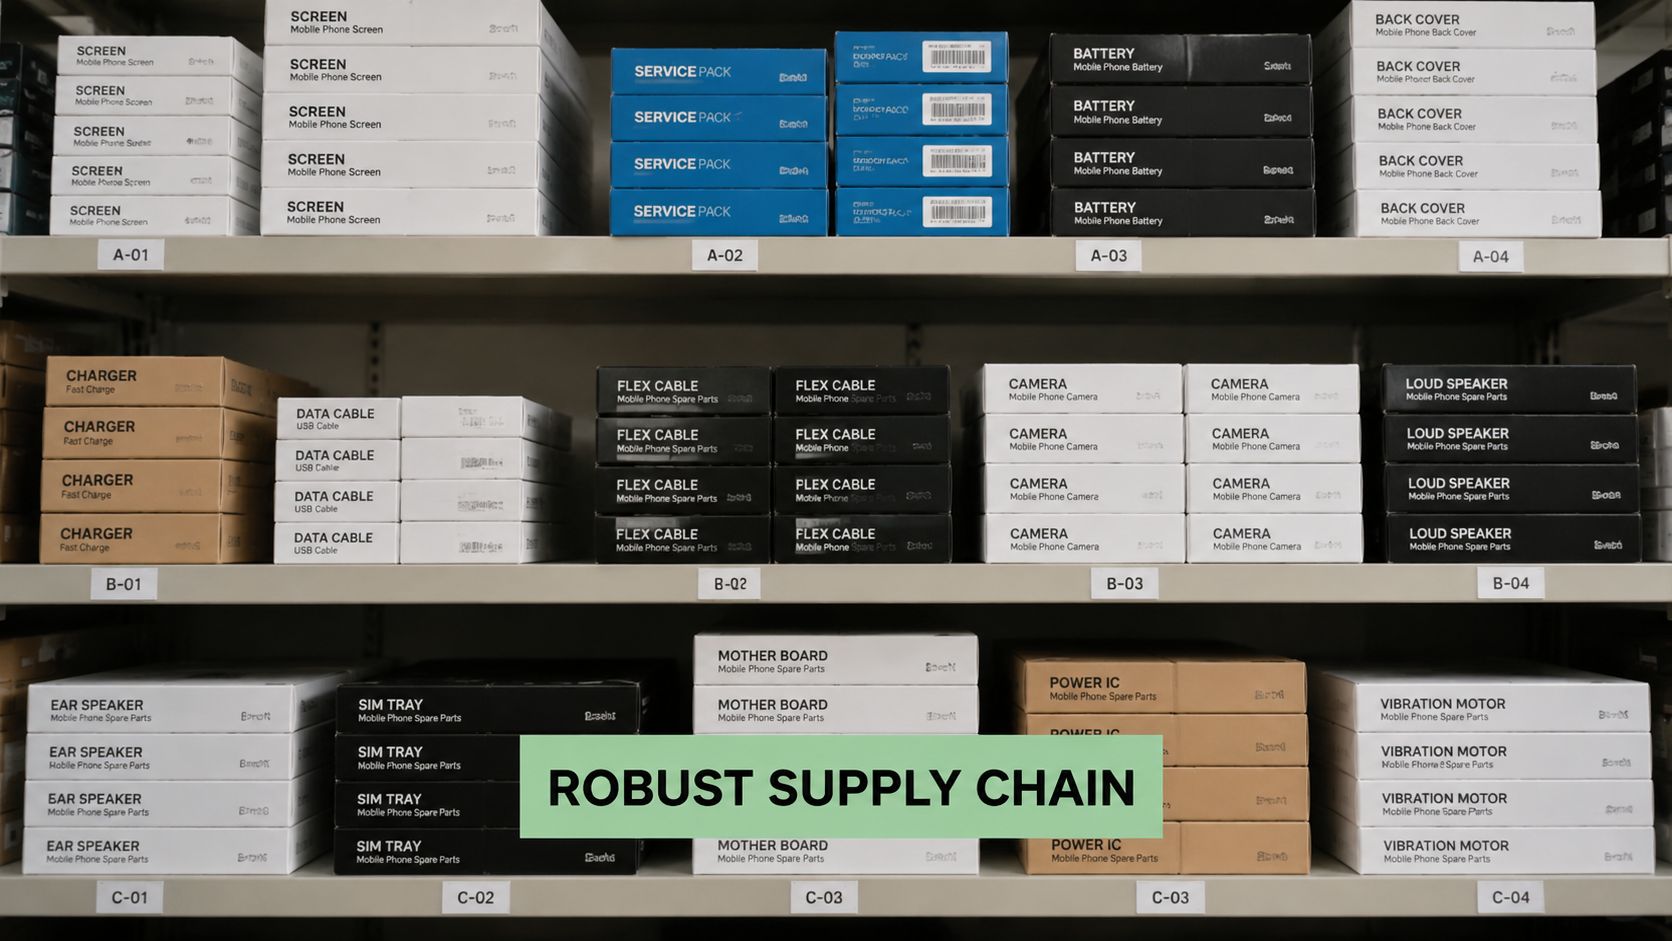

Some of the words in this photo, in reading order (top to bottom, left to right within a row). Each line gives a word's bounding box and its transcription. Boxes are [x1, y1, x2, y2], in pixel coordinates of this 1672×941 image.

[291, 11, 347, 22] SCREEN
[1376, 14, 1412, 25] BACK
[1415, 14, 1460, 25] COVER
[1405, 28, 1430, 36] Phone
[1432, 28, 1452, 36] Back
[1453, 28, 1477, 37] Cover
[77, 46, 126, 56] SCREEN
[1074, 48, 1135, 59] BATTERY
[290, 59, 346, 70] SCREEN
[1377, 61, 1413, 72] BACK
[1416, 61, 1460, 72] COVER
[635, 65, 697, 77] SERVICE
[699, 67, 731, 77] PACK
[76, 85, 125, 96] SCREEN
[289, 106, 345, 117] SCREEN
[1074, 100, 1135, 112] BATTERY
[634, 111, 697, 123] SERVICE
[699, 112, 730, 123] PACK
[1378, 108, 1414, 119] BACK
[1417, 108, 1462, 119] COVER
[320, 120, 347, 129] Phone
[349, 120, 381, 129] Screen
[74, 126, 124, 137] SCREEN
[288, 153, 345, 165] SCREEN
[1074, 152, 1135, 163] BATTERY
[1379, 155, 1415, 166] BACK
[1419, 155, 1463, 166] COVER
[634, 158, 696, 170] SERVICE
[699, 159, 730, 169] PACK
[1103, 166, 1130, 175] Phone
[1132, 166, 1163, 177] Battery
[70, 205, 121, 216] SCREEN
[287, 201, 344, 212] SCREEN
[634, 205, 696, 217] SERVICE
[699, 206, 730, 216] PACK
[1075, 202, 1136, 213] BATTERY
[1381, 203, 1417, 214] BACK
[1420, 203, 1465, 214] COVER
[113, 248, 147, 261] A-01
[707, 249, 743, 262] A-02
[1091, 249, 1127, 262] A-03
[1473, 250, 1509, 263] A-04
[66, 369, 137, 382] CHARGER
[618, 380, 650, 391] FLEX
[655, 380, 698, 392] CABLE
[796, 380, 828, 391] FLEX
[832, 379, 875, 391] CABLE
[1009, 378, 1067, 389] CAMERA
[1211, 378, 1269, 390] CAMERA
[1406, 378, 1443, 389] LOUD
[1447, 378, 1508, 389] SPEAKER
[1434, 393, 1460, 401] Phone
[1462, 392, 1485, 402] Spare
[1486, 392, 1507, 401] Parts
[297, 408, 330, 419] DATA
[333, 408, 374, 419] CABLE
[64, 420, 135, 433] CHARGER
[617, 429, 651, 441] FLEX
[655, 429, 698, 441] CABLE
[796, 428, 828, 440] FLEX
[832, 428, 876, 440] CABLE
[1009, 428, 1067, 439] CAMERA
[1212, 428, 1269, 439] CAMERA
[1407, 428, 1444, 439] LOUD
[1448, 427, 1509, 439] SPEAKER
[296, 450, 330, 461] DATA
[333, 449, 374, 461] CABLE
[62, 474, 133, 487] CHARGER
[617, 479, 650, 491] FLEX
[654, 479, 698, 491] CABLE
[1010, 478, 1068, 489] CAMERA
[1213, 478, 1270, 489] CAMERA
[1409, 477, 1446, 489] LOUD
[1449, 477, 1510, 489] SPEAKER
[81, 490, 112, 501] Charge
[295, 491, 329, 502] DATA
[332, 491, 373, 502] CABLE
[1241, 492, 1267, 500] Phone
[1269, 492, 1301, 501] Camera
[60, 527, 133, 540] CHARGER
[294, 532, 328, 543] DATA
[331, 532, 373, 543] CABLE
[617, 528, 650, 540] FLEX
[654, 528, 698, 540] CABLE
[796, 528, 829, 540] FLEX
[832, 528, 875, 540] CABLE
[1010, 528, 1068, 539] CAMERA
[1213, 528, 1271, 539] CAMERA
[1410, 528, 1447, 539] LOUD
[1450, 528, 1511, 539] SPEAKER
[106, 578, 140, 591] B-01
[1107, 577, 1143, 590] B-03
[1493, 577, 1529, 590] B-04
[718, 650, 776, 661] MOTHER
[780, 650, 828, 661] BOARD
[748, 664, 775, 673] Phone
[777, 664, 801, 675] Spare
[803, 664, 825, 673] Parts
[1050, 677, 1102, 689] POWER
[1106, 677, 1120, 688] IC
[51, 699, 78, 711] EAR
[81, 699, 143, 711] SPEAKER
[359, 699, 383, 711] SIM
[387, 699, 423, 710] TRAY
[718, 699, 776, 710] MOTHER
[780, 699, 828, 710] BOARD
[1380, 698, 1452, 709] VIBRATION
[1456, 698, 1506, 709] MOTOR
[1411, 712, 1438, 721] Phone
[1440, 712, 1465, 722] Spare
[1466, 712, 1489, 721] Parts
[49, 746, 76, 758] EAR
[80, 746, 142, 758] SPEAKER
[358, 746, 383, 758] SIM
[386, 746, 423, 758] TRAY
[1381, 746, 1453, 757] VIBRATION
[1457, 746, 1507, 757] MOTOR
[357, 793, 382, 805] SIM
[386, 793, 422, 805] TRAY
[1382, 793, 1453, 804] VIBRATION
[1458, 793, 1507, 804] MOTOR
[47, 840, 73, 852] EAR
[77, 840, 140, 852] SPEAKER
[357, 840, 381, 852] SIM
[385, 840, 422, 852] TRAY
[718, 840, 776, 851] MOTHER
[780, 839, 828, 851] BOARD
[1052, 839, 1103, 851] POWER
[1108, 839, 1121, 851] IC
[1384, 840, 1456, 851] VIBRATION
[1460, 840, 1509, 851] MOTOR
[112, 891, 147, 904] C-01
[458, 891, 494, 904] C-02
[806, 891, 843, 904] C-03
[1152, 891, 1189, 904] C-03
[1492, 891, 1530, 904] C-04
